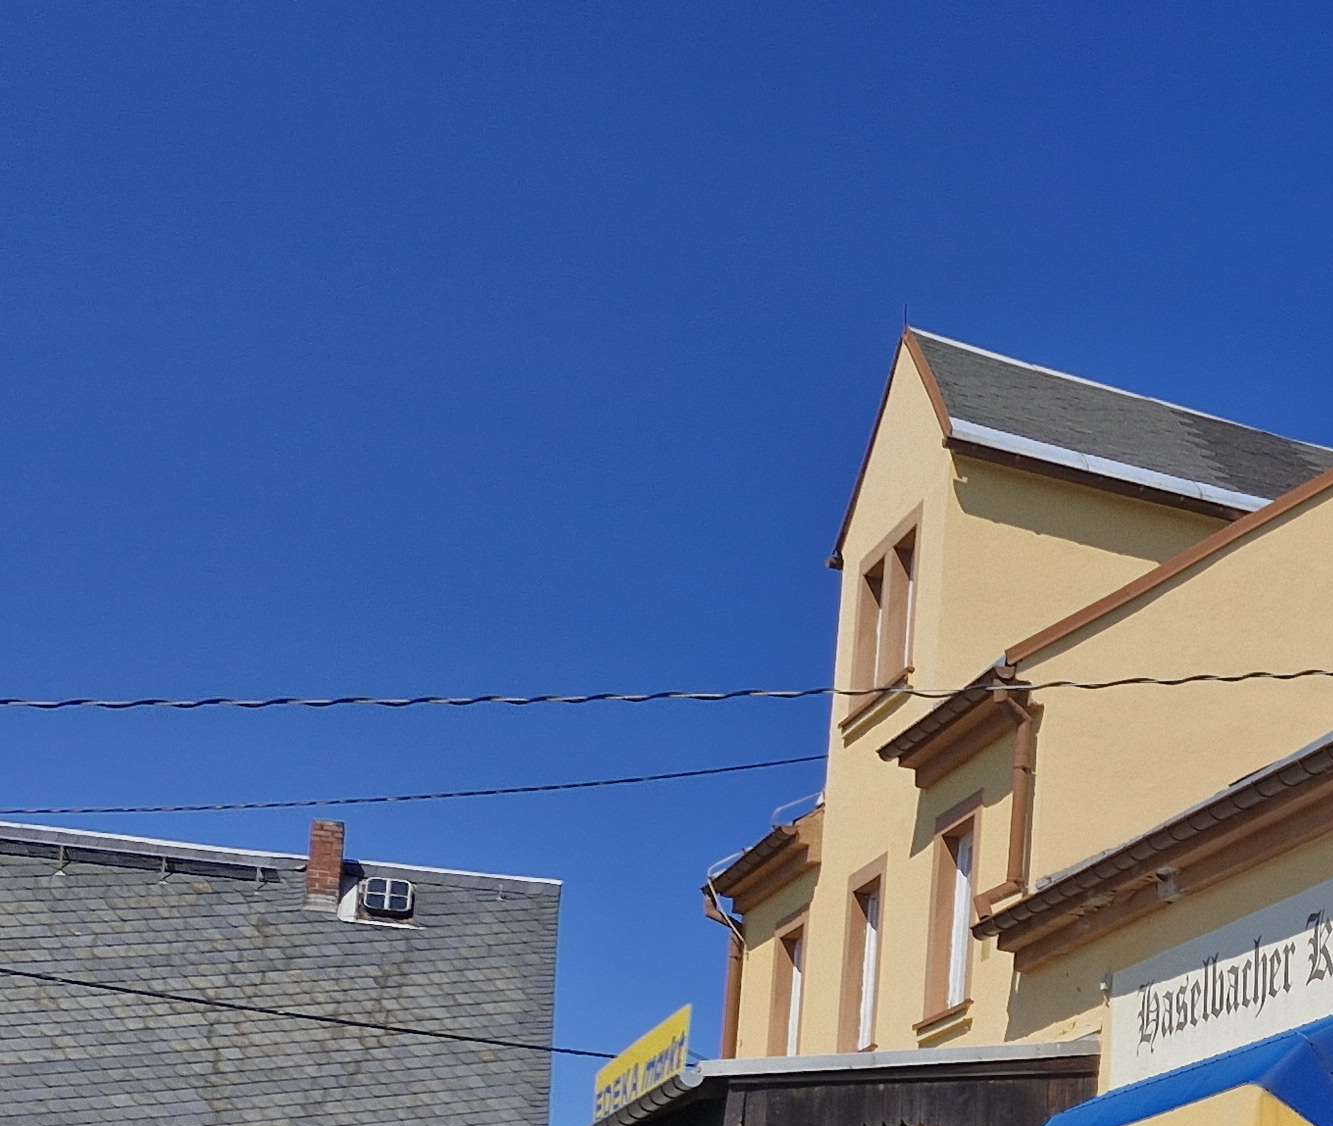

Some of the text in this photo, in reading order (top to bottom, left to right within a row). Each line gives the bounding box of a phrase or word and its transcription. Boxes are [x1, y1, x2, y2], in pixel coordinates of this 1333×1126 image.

[1136, 935, 1296, 1057] Haselbacher
[596, 1029, 685, 1116] EDEKA markt
